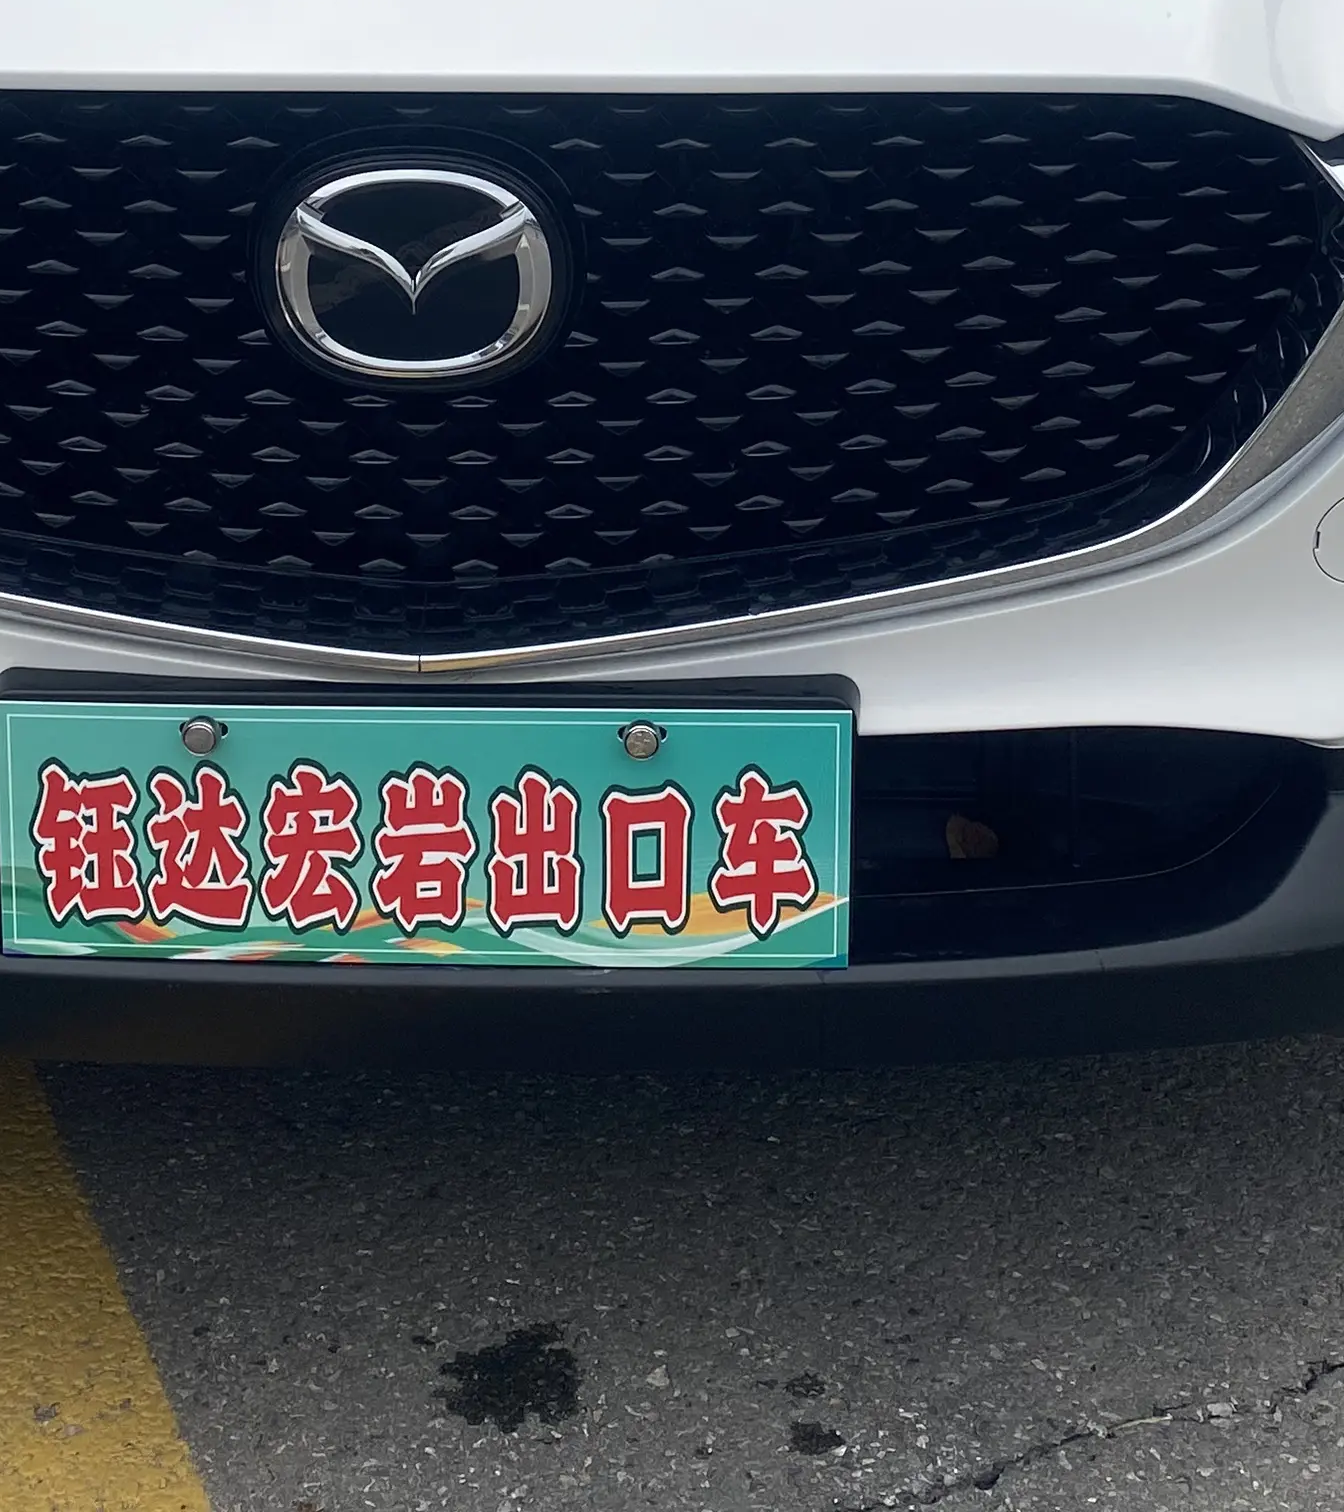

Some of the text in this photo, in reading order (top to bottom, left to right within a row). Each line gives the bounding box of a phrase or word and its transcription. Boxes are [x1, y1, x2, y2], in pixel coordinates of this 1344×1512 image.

[32, 760, 817, 936] 钰达宏岩出口车
